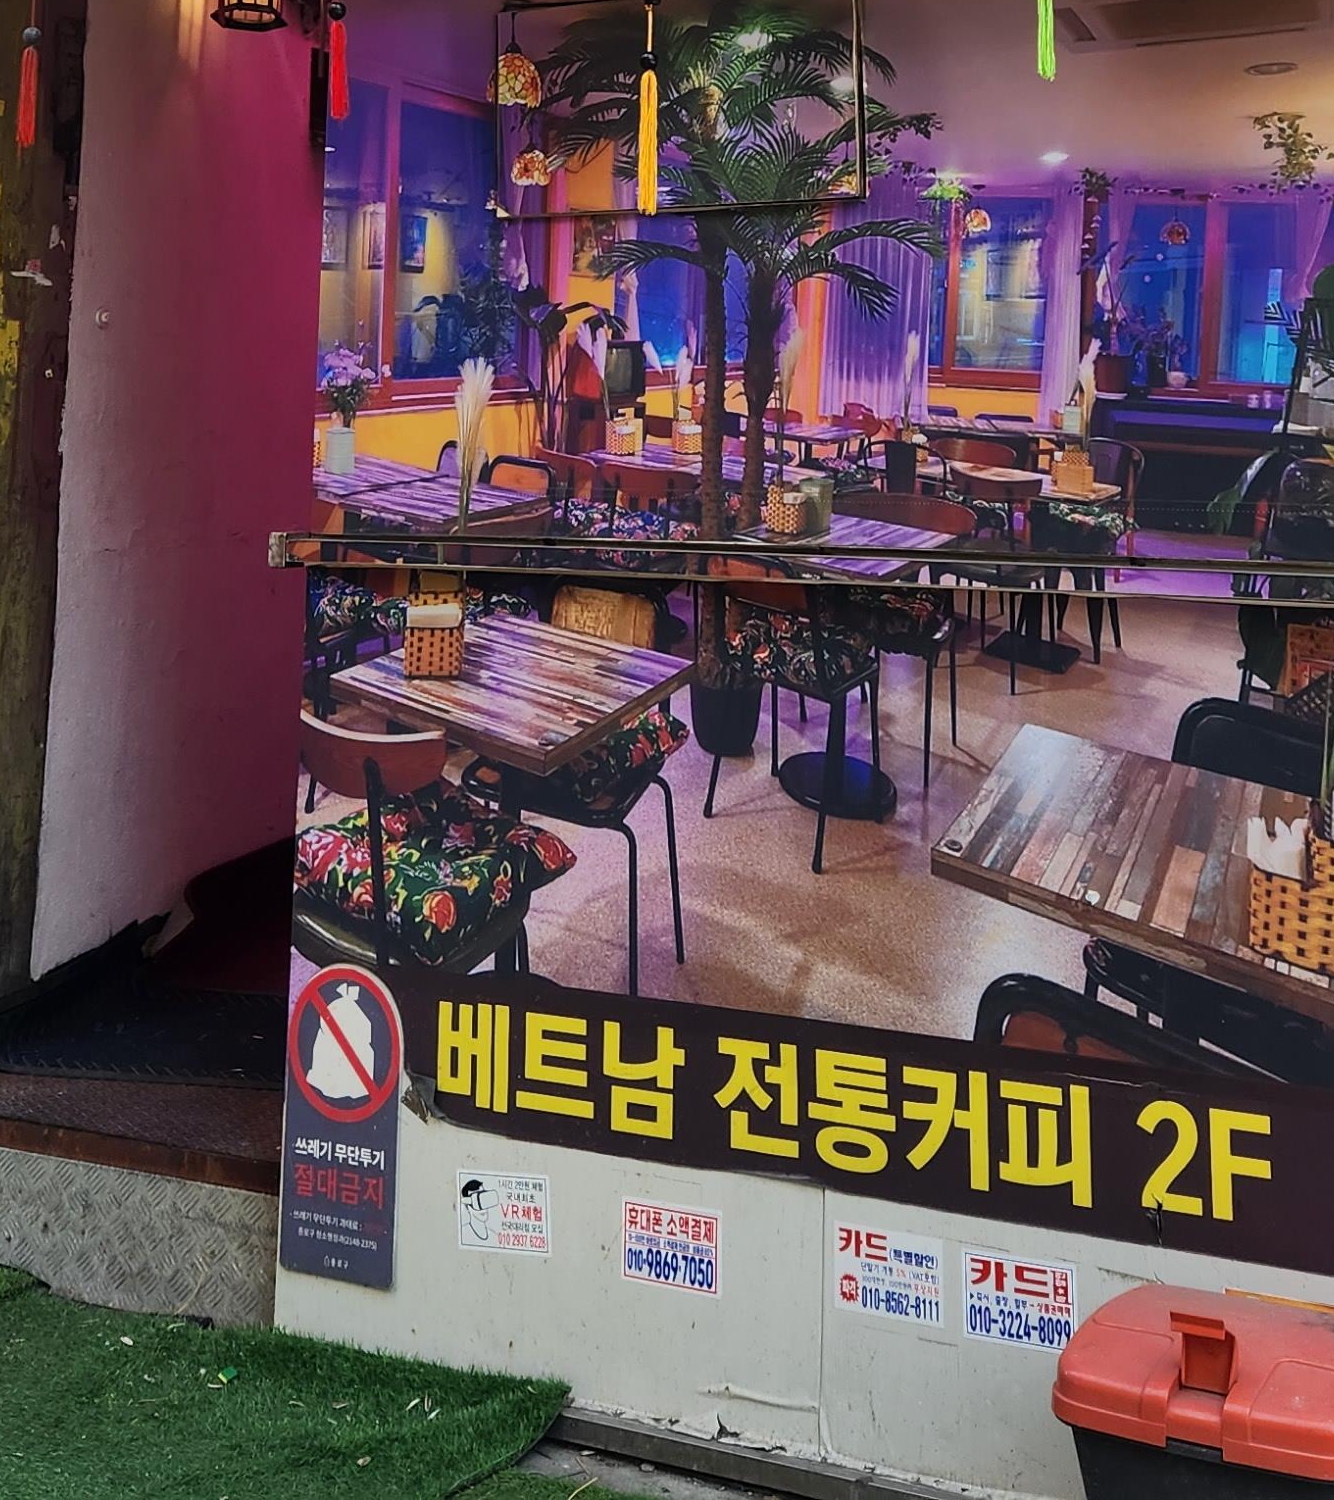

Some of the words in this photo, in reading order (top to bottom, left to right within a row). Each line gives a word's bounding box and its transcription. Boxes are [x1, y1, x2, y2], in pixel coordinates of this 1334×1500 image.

[436, 1000, 685, 1140] 베트남
[713, 1037, 1093, 1208] 전통커피
[1134, 1100, 1272, 1221] 2F
[295, 1136, 332, 1162] 쓰레기
[334, 1143, 385, 1171] 무단투기
[294, 1163, 385, 1211] 절대금지
[628, 1206, 663, 1234] 휴대폰
[667, 1213, 715, 1245] 소액결제
[839, 1227, 889, 1263] 카드
[970, 1257, 1050, 1299] 카드
[969, 1303, 1072, 1347] 010-3224-8099
